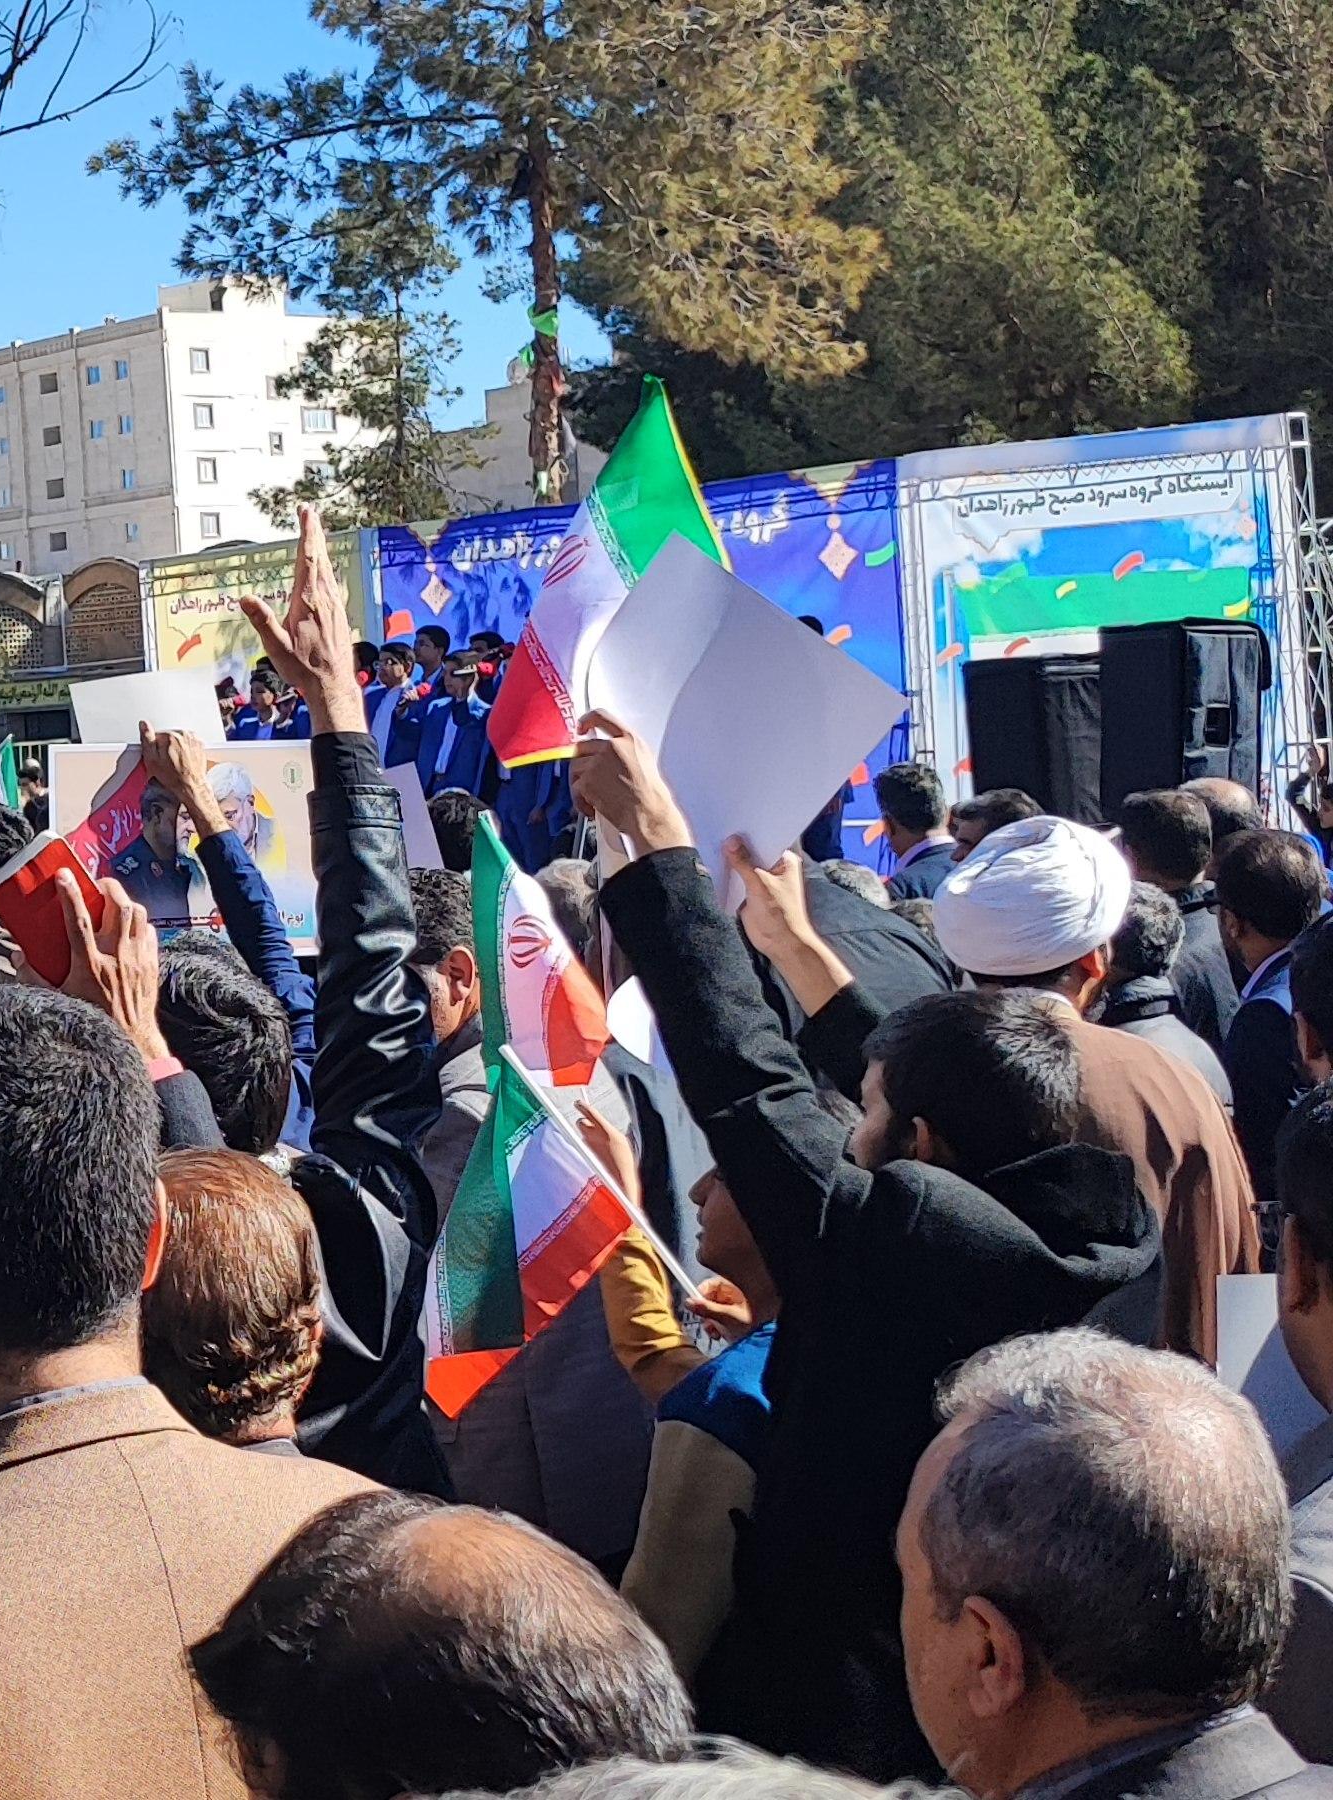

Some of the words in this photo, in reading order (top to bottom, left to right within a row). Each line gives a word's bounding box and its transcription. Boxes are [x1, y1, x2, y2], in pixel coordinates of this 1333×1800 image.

[1128, 475, 1163, 504] گروه
[1167, 471, 1234, 497] ایستگاه
[956, 492, 1011, 518] زاهدان
[1010, 487, 1046, 517] ظهور
[1047, 491, 1085, 515] صبح
[1087, 487, 1128, 508] سرود
